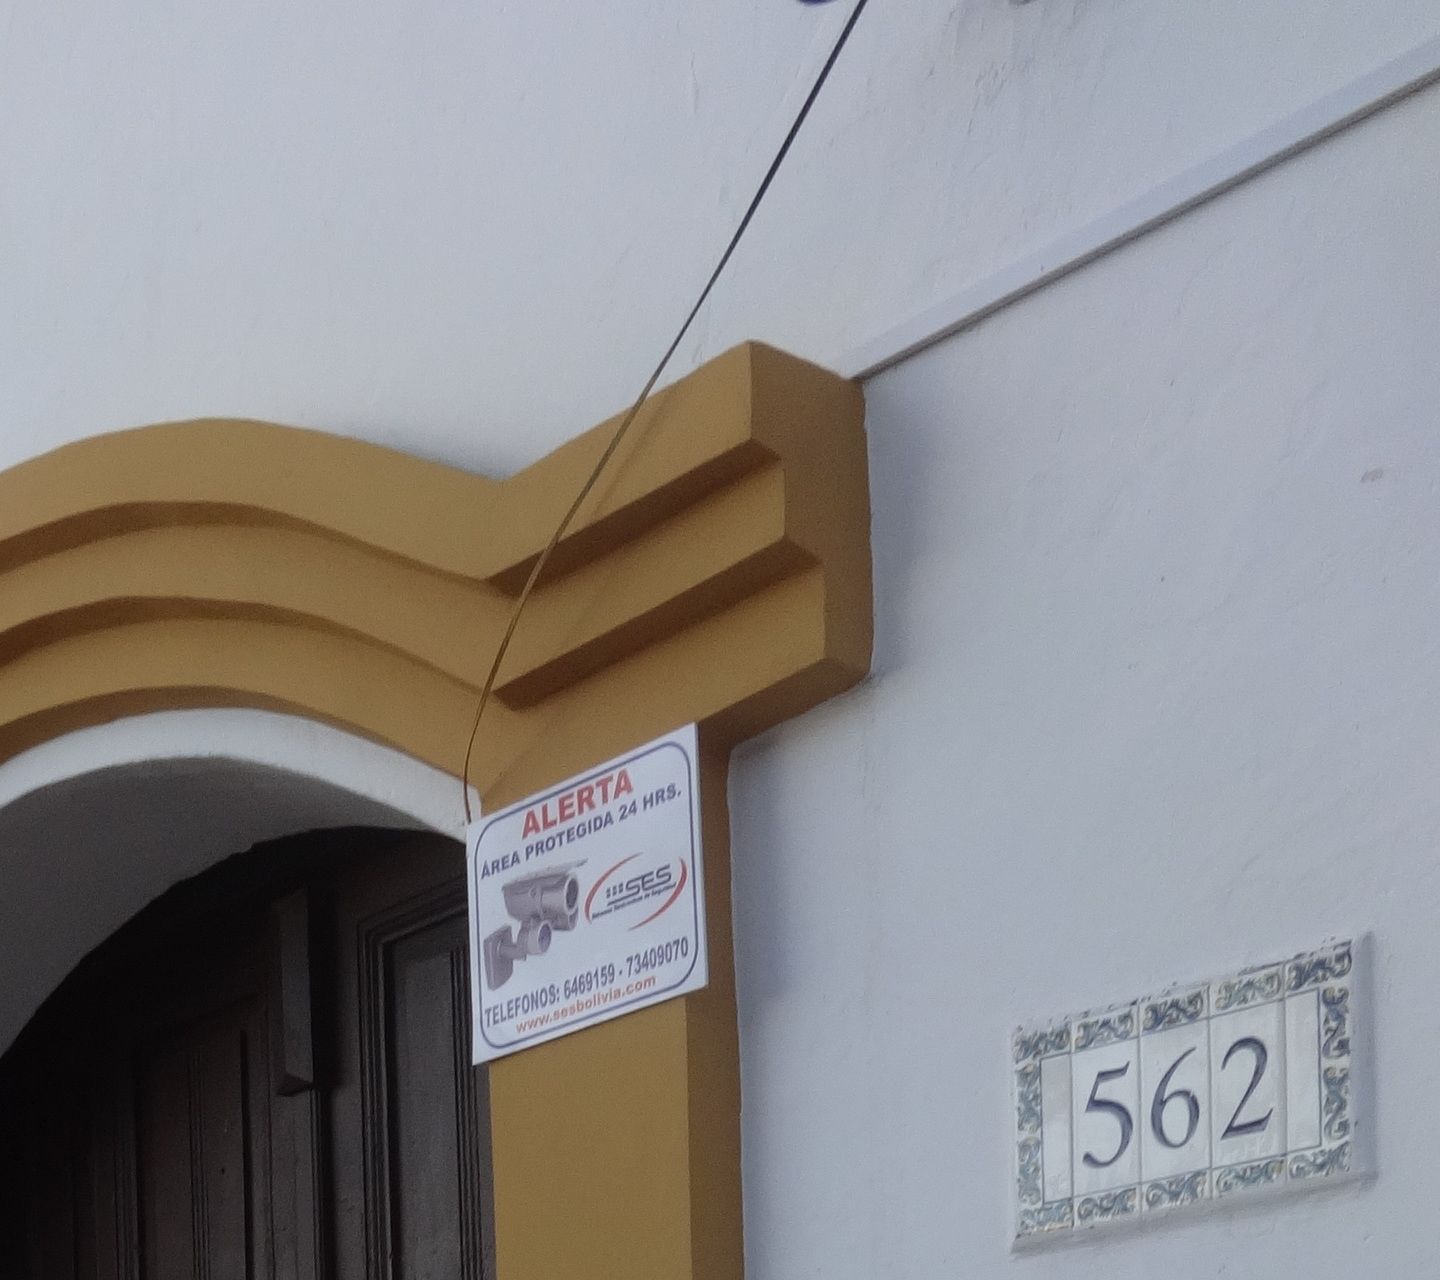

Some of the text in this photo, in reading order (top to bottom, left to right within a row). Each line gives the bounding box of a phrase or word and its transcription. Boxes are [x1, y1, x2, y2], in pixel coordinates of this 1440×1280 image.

[522, 768, 633, 840] ALERTA
[526, 812, 614, 861] PROTEGIDA
[618, 800, 637, 822] 24
[643, 783, 682, 811] HRS.
[484, 984, 560, 1029] TELEFONOS:
[563, 962, 615, 1000] 6469159
[626, 936, 688, 978] 73409070
[1082, 1036, 1274, 1169] 562
